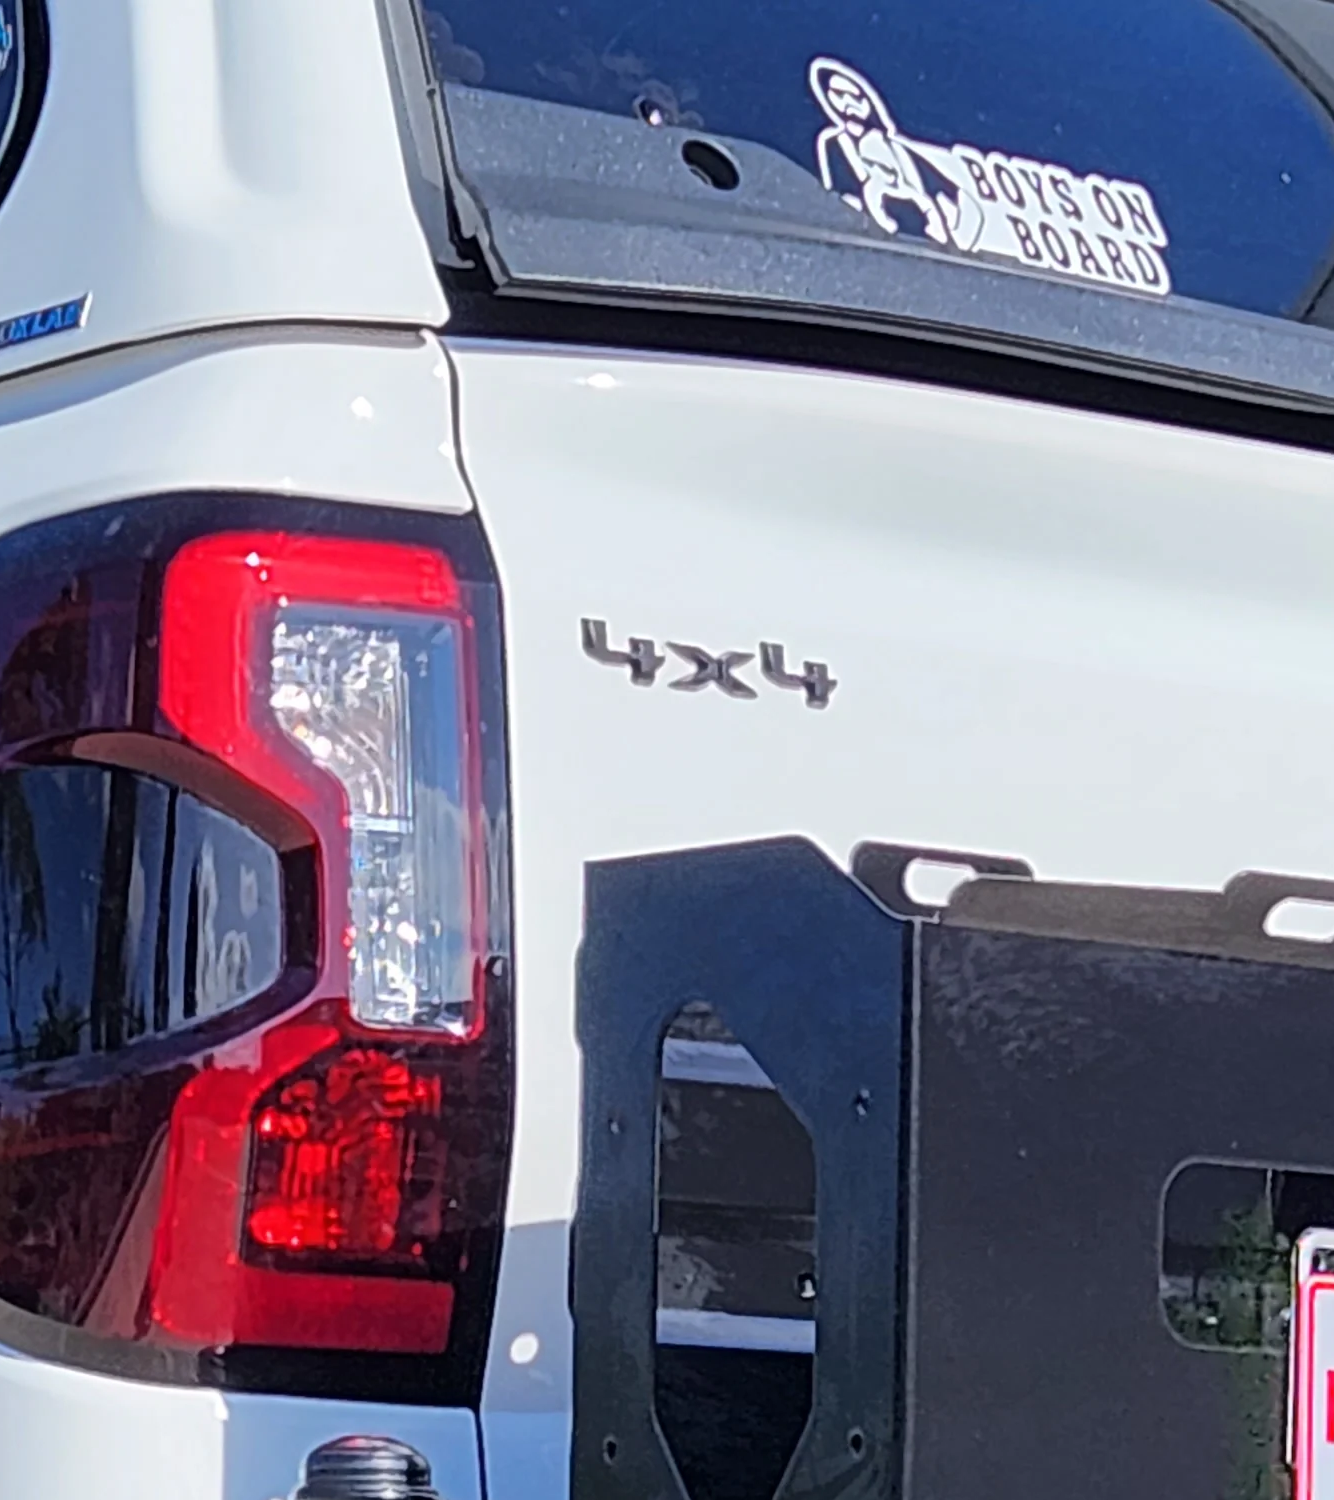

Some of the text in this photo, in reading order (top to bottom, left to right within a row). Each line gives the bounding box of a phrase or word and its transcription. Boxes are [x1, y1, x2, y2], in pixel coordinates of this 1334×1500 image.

[960, 154, 1158, 239] BOYS ON
[1005, 213, 1161, 287] BOARD
[580, 616, 838, 710] 4X4
